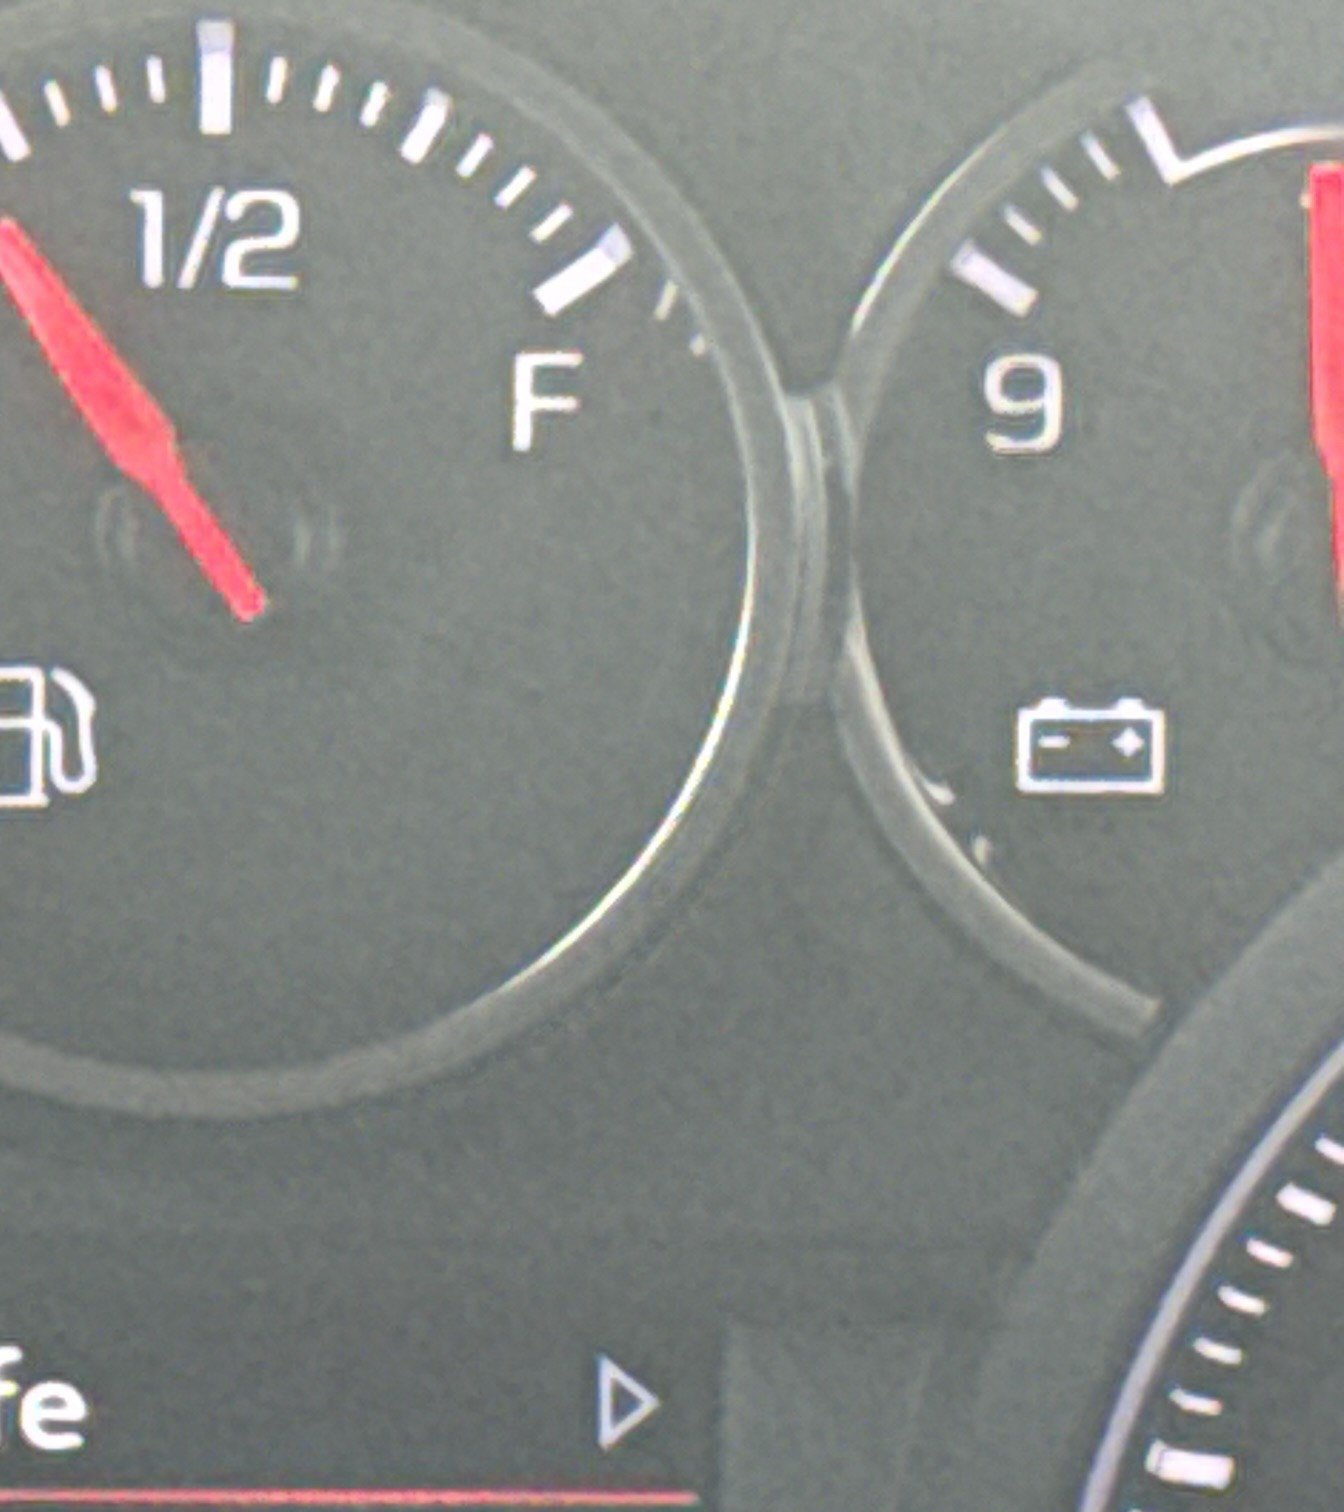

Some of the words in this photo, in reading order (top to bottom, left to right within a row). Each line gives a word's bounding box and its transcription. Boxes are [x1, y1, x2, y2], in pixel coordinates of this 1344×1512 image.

[128, 186, 301, 291] 1/2
[511, 349, 584, 453] F
[983, 352, 1064, 452] 9
